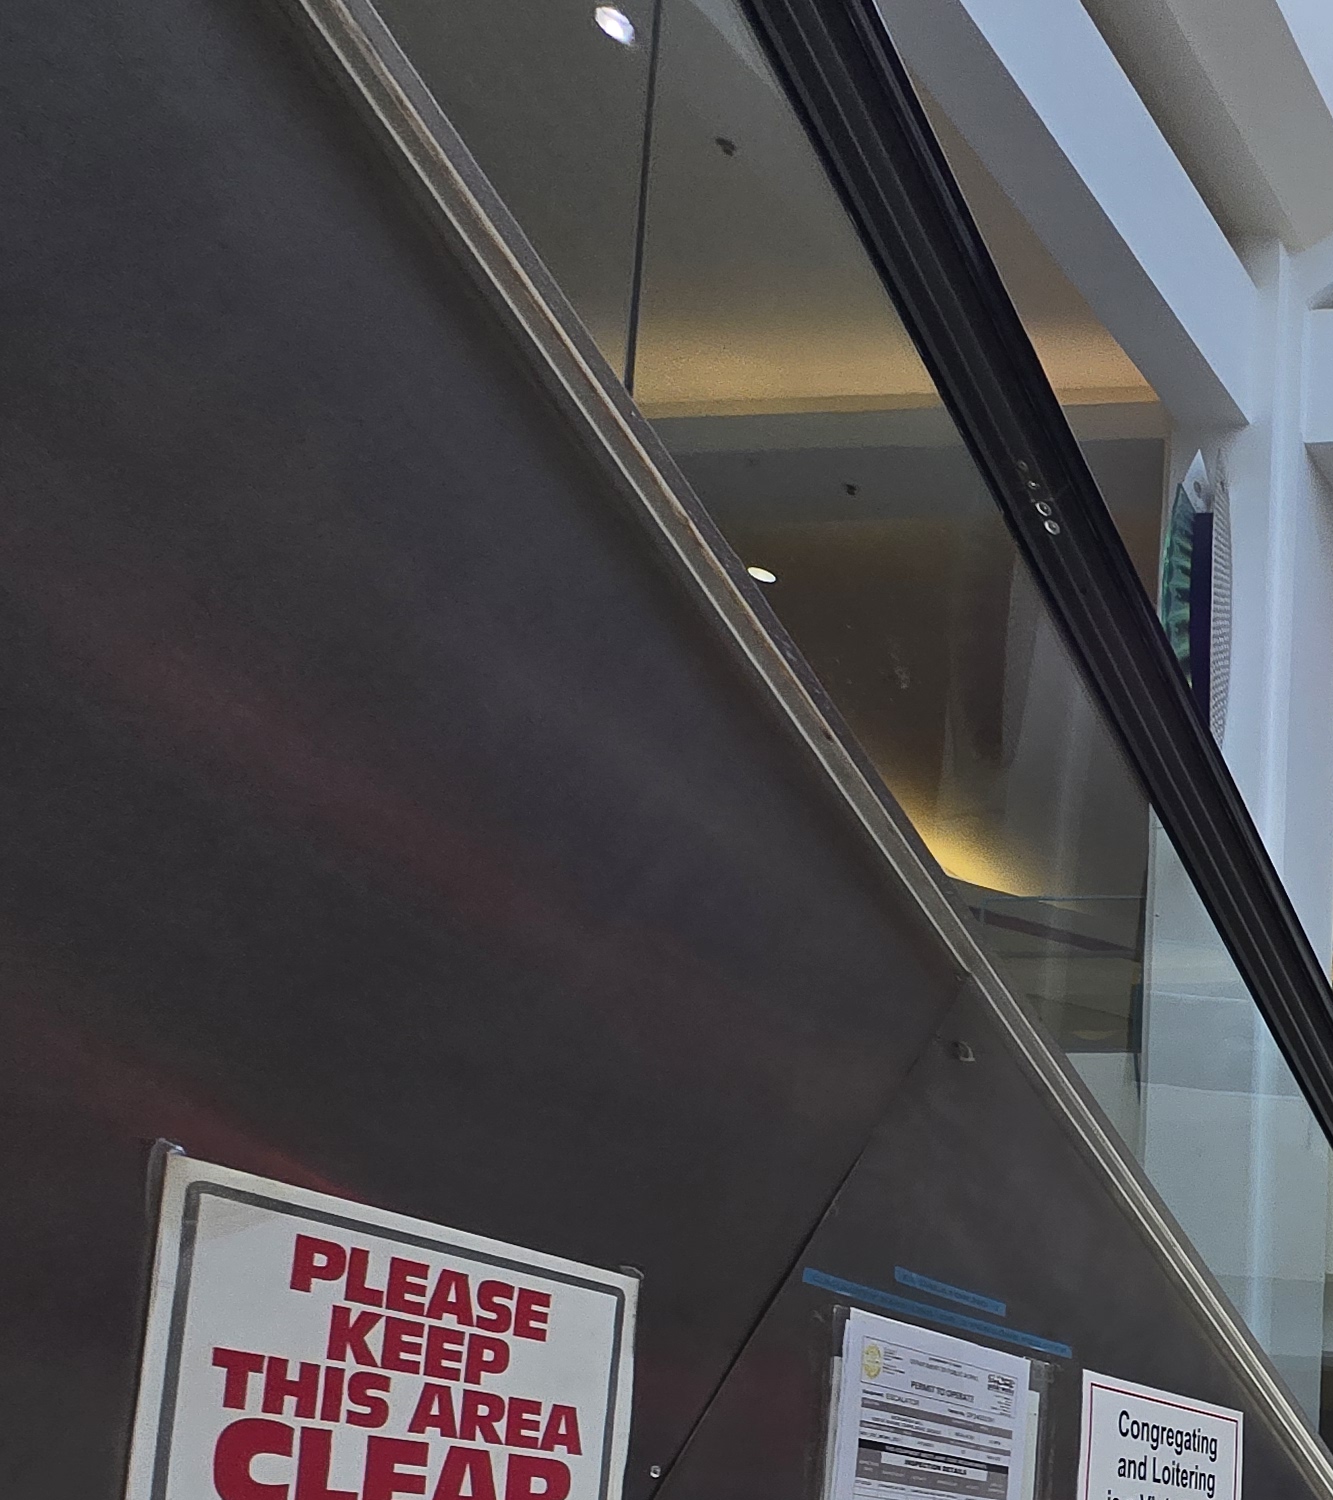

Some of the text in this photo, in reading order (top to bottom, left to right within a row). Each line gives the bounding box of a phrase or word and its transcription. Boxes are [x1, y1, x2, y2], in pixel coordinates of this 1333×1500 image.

[289, 1233, 552, 1343] PLEASE
[326, 1304, 510, 1386] KEEP
[211, 1347, 583, 1456] THIS AREA
[1118, 1409, 1218, 1463] Congregating
[1117, 1455, 1216, 1499] and Loitering
